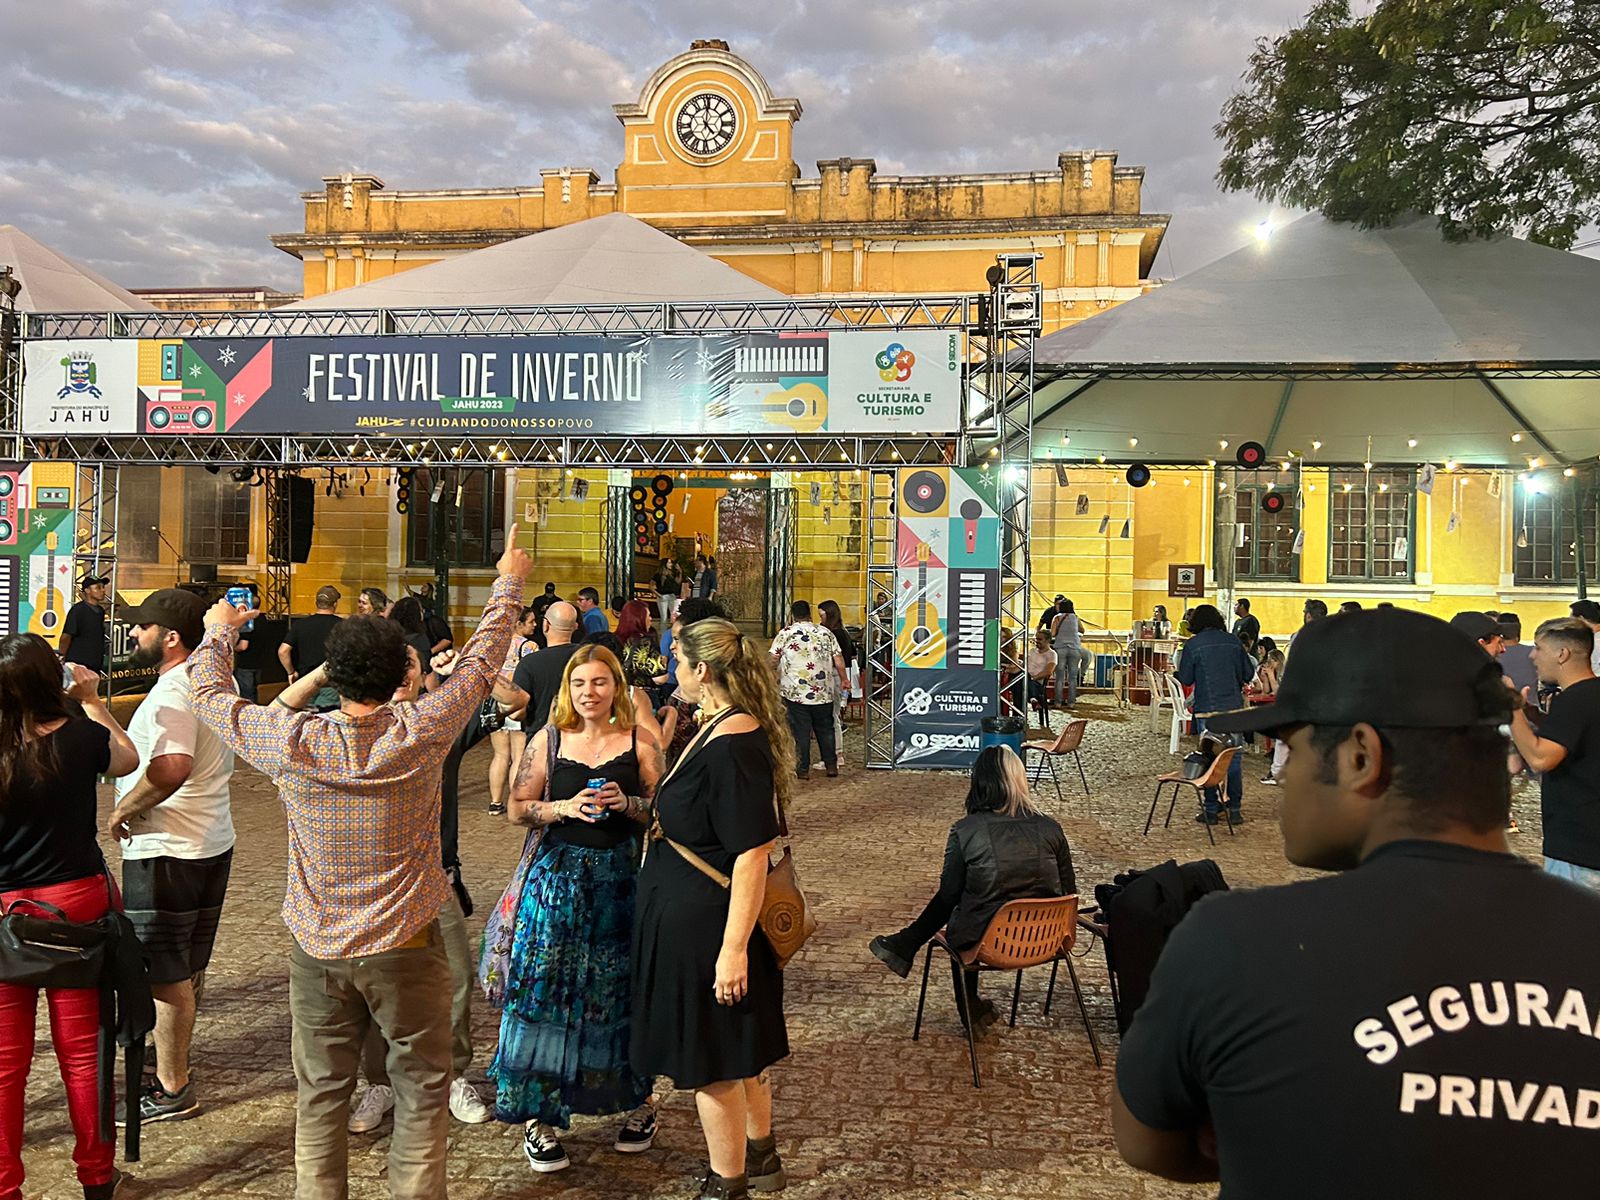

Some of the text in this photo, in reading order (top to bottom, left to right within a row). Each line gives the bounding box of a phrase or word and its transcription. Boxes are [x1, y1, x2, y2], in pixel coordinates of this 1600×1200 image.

[308, 352, 642, 402] FESTIVAL DE INVERNO
[857, 393, 932, 403] CULTURA E
[452, 400, 503, 409] JAHU 2023
[863, 405, 925, 415] TURISMO
[49, 410, 109, 422] JAHU
[355, 416, 593, 428] JAHU #CUIDANDODONOSSOPOVO
[934, 694, 988, 704] CULTURA E
[938, 703, 984, 713] TURISMO
[1353, 981, 1600, 1065] SEGURA
[1400, 1072, 1600, 1129] PRIVAD
